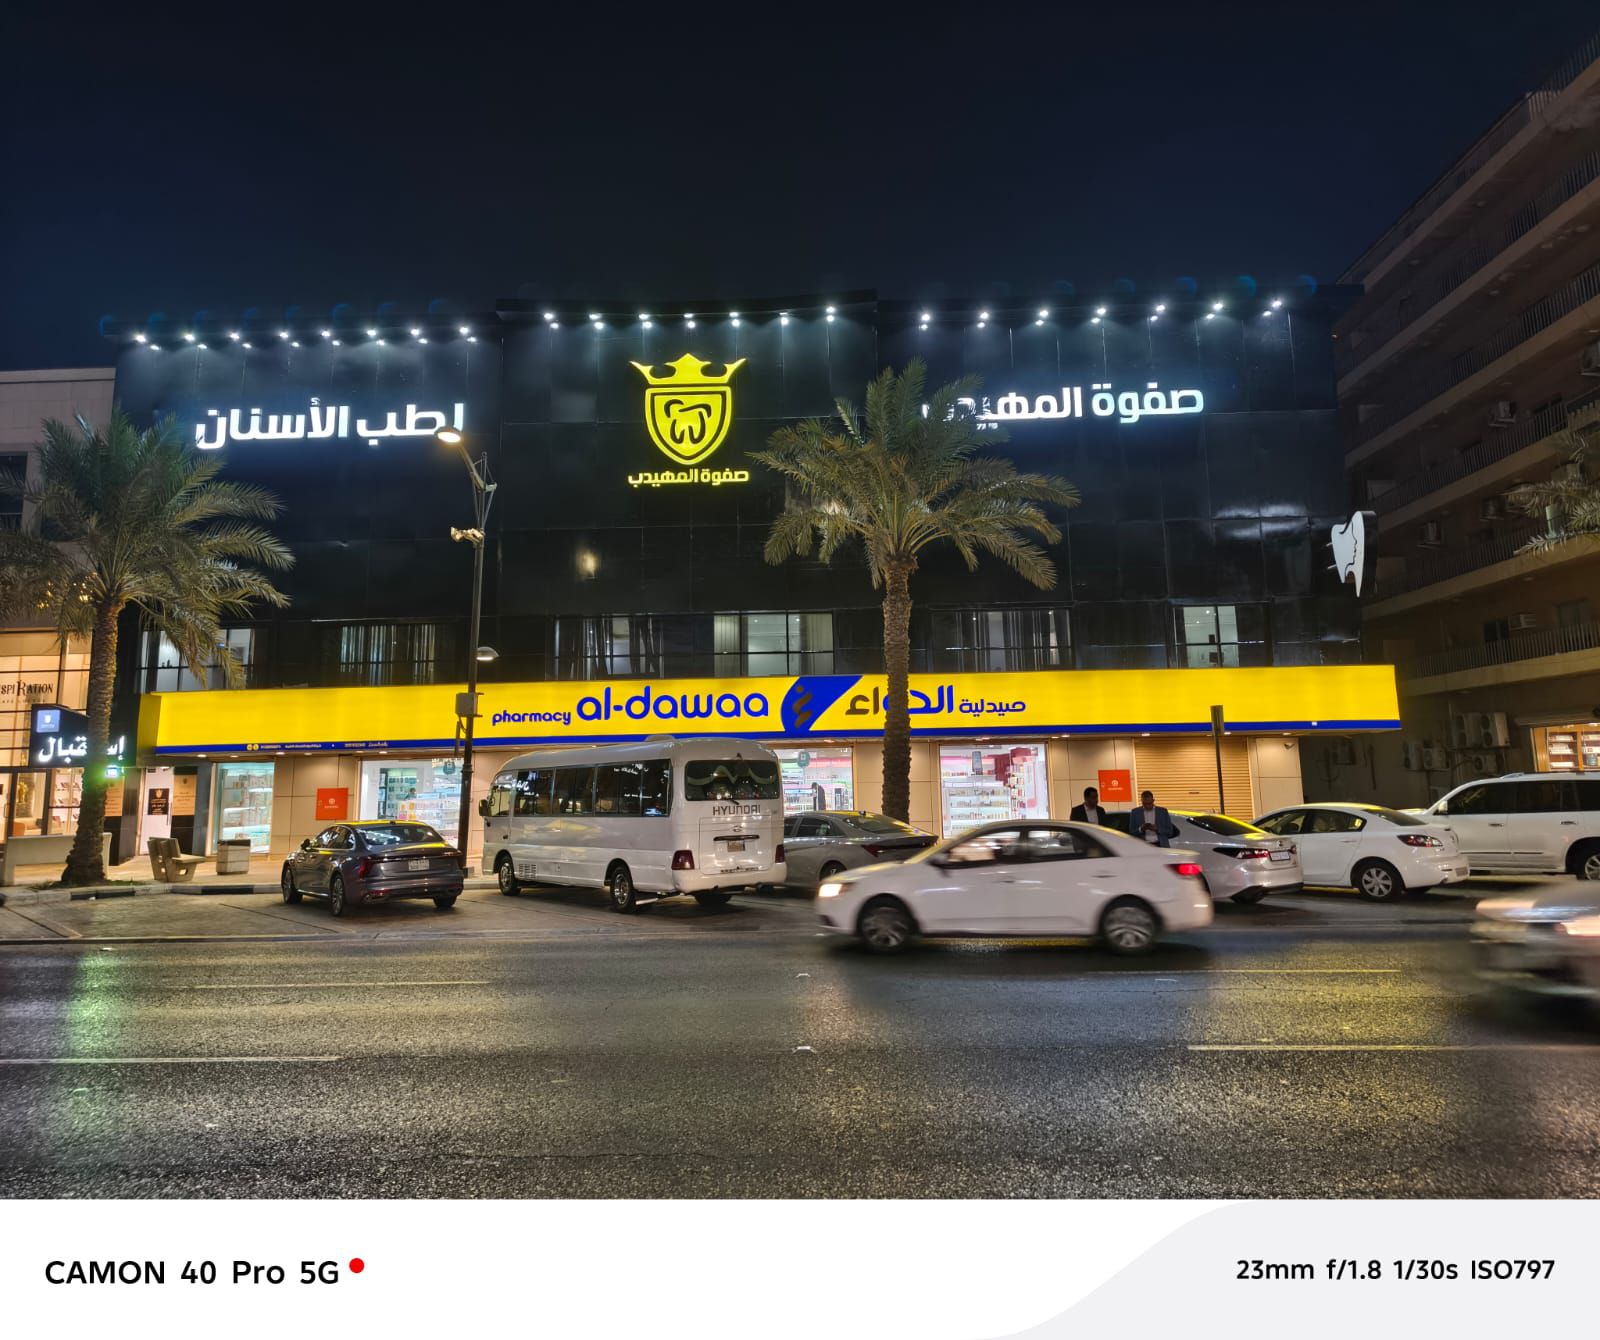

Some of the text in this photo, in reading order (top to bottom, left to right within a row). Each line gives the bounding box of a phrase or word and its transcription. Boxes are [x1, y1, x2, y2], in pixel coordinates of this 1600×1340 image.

[1091, 382, 1204, 424] صفوة
[195, 397, 464, 450] لطب الأسنان
[627, 467, 750, 488] صفوة المهيدب
[491, 685, 769, 726] pharmacy al-dawaa
[845, 684, 1026, 718] صيدلية الداء
[712, 804, 761, 816] HYUNDAI
